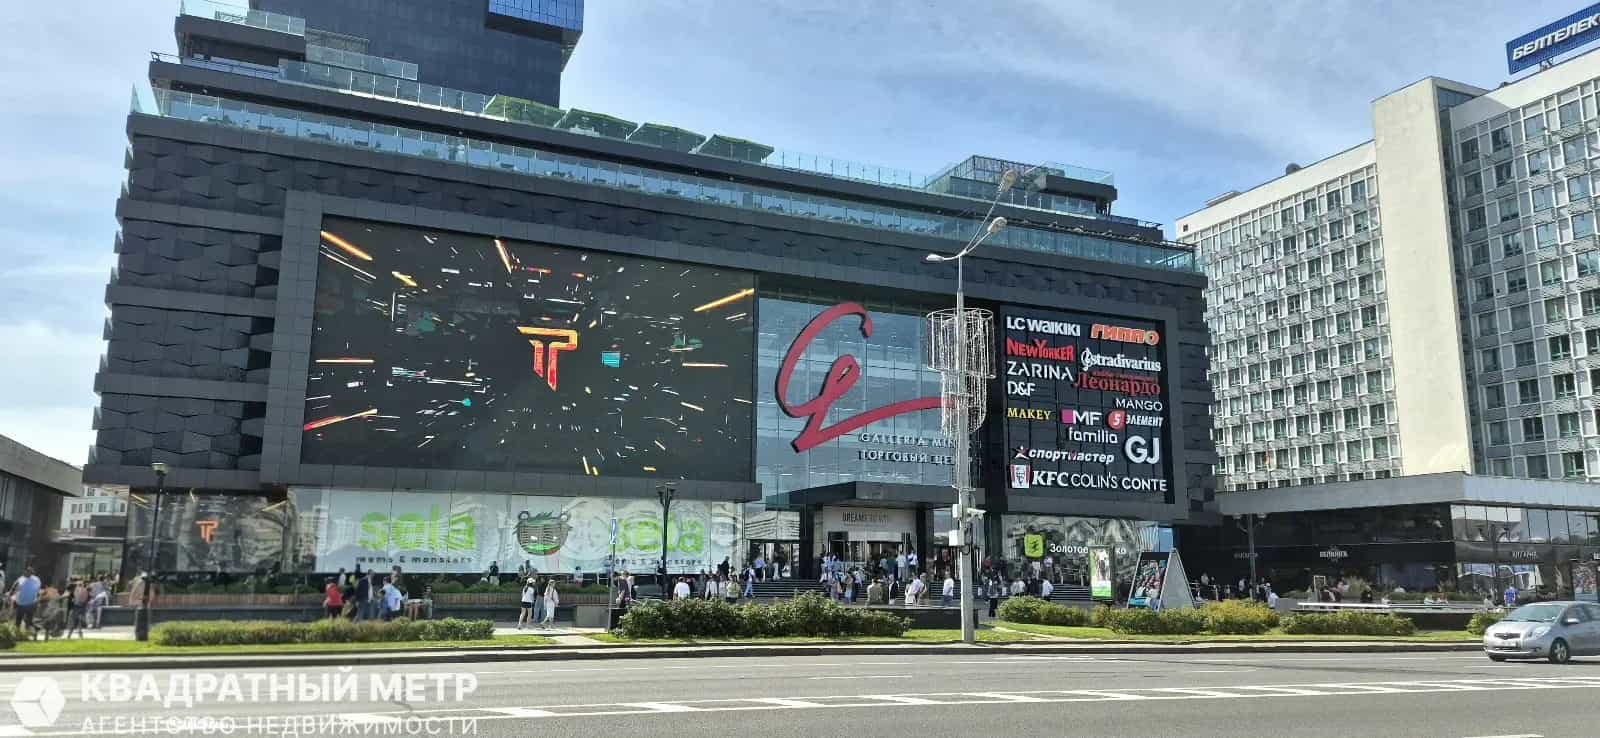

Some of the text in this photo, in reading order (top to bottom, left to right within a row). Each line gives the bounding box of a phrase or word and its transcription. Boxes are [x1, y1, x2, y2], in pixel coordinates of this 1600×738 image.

[1007, 316, 1025, 330] LC
[1007, 361, 1073, 381] ZARINA
[1008, 381, 1036, 396] D&F
[1074, 372, 1160, 396] Леонардо
[1115, 398, 1162, 411] MANGO
[1008, 408, 1051, 419] MAKEY
[1073, 411, 1102, 425] MF
[1126, 415, 1163, 427] ЭЛЕМЕНТ
[860, 433, 929, 447] GALLERIA
[1069, 427, 1118, 444] familia
[859, 450, 928, 463] ТОРГОВЫЙ
[1029, 449, 1114, 464] спортмастер
[1125, 436, 1160, 464] GJ
[1032, 471, 1069, 486] KFC
[1071, 473, 1117, 489] COLIN'S
[1122, 477, 1168, 491] CONTE
